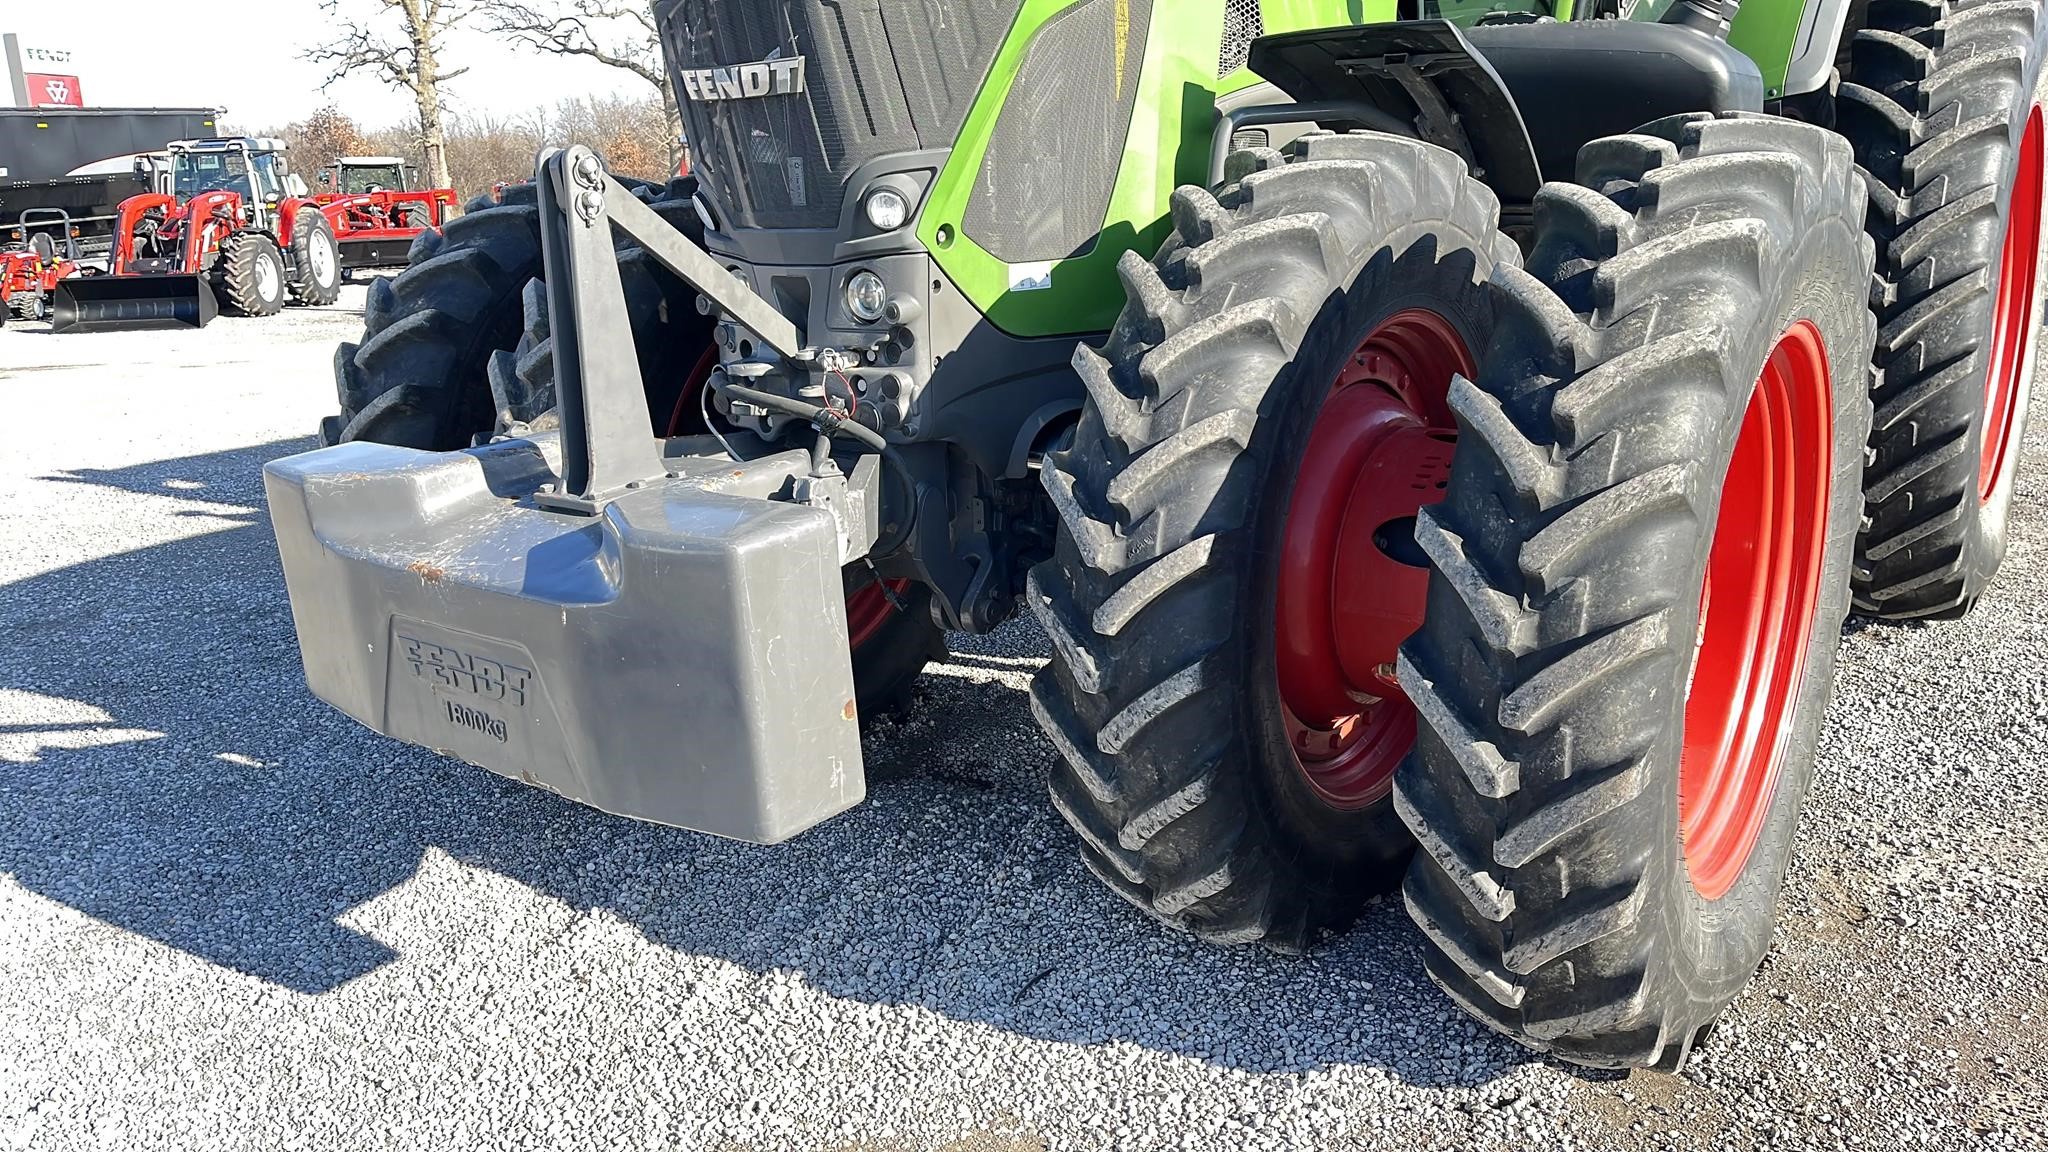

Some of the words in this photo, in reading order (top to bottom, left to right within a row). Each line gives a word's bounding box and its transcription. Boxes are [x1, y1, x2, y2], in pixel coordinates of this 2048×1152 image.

[27, 48, 71, 62] FENDT
[681, 60, 799, 100] FENDT
[398, 635, 532, 706] FENDT
[444, 700, 508, 743] 1800kg
